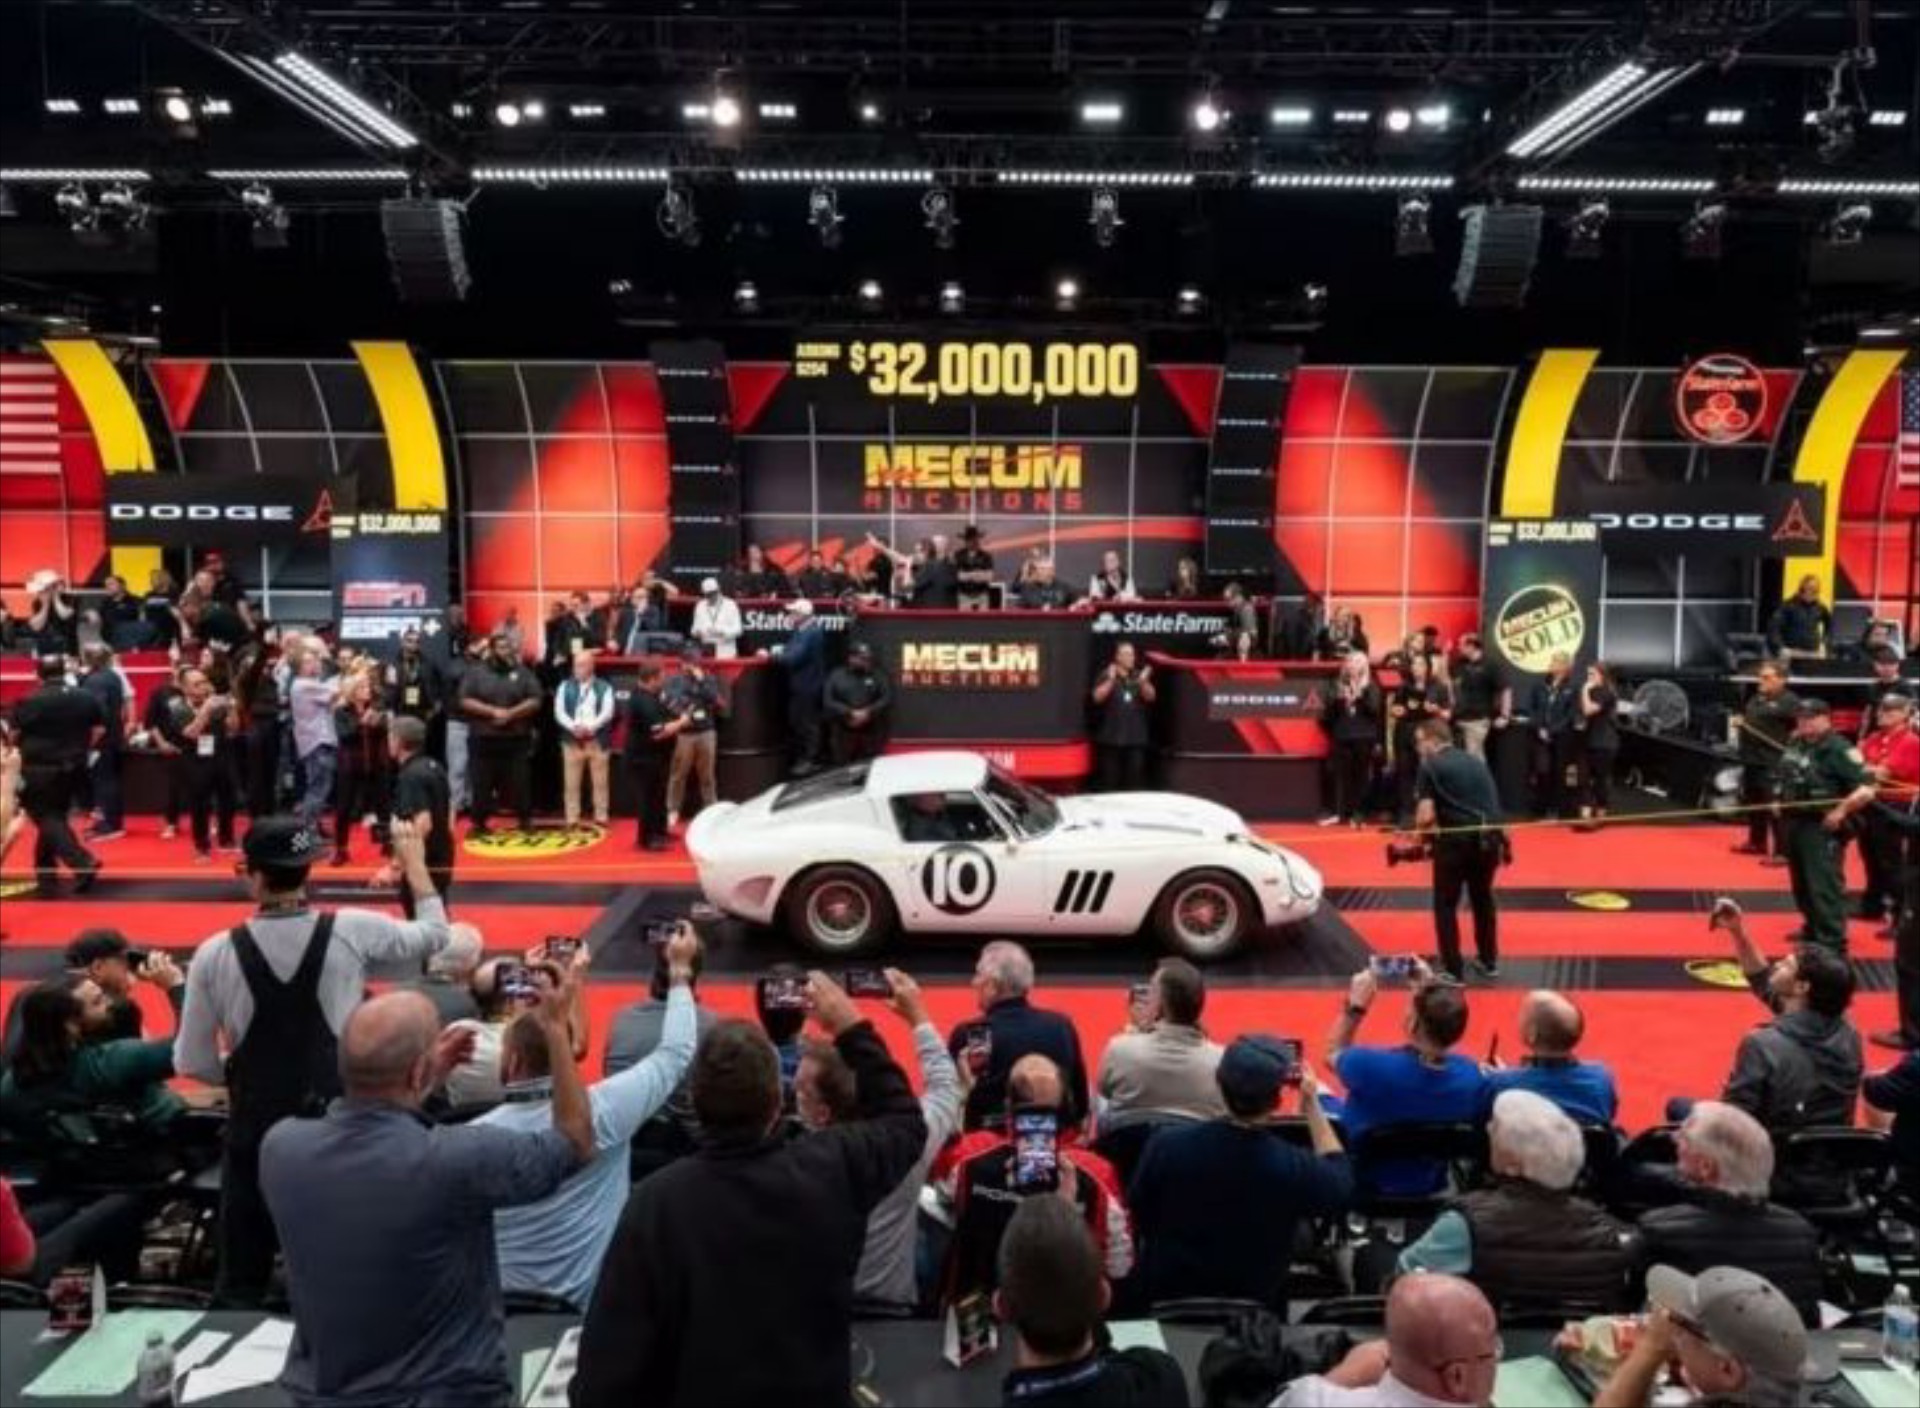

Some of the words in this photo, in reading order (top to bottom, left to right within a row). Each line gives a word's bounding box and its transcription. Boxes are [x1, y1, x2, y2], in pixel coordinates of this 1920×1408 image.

[849, 341, 1138, 404] $32,000,000
[864, 444, 1083, 488] MECUM
[110, 504, 293, 520] DODGE
[862, 492, 1083, 510] AUCTIONS
[1507, 615, 1581, 659] SOLD
[903, 642, 1038, 672] MECUM
[902, 671, 1039, 686] AUCTIONS
[931, 850, 989, 907] 10
